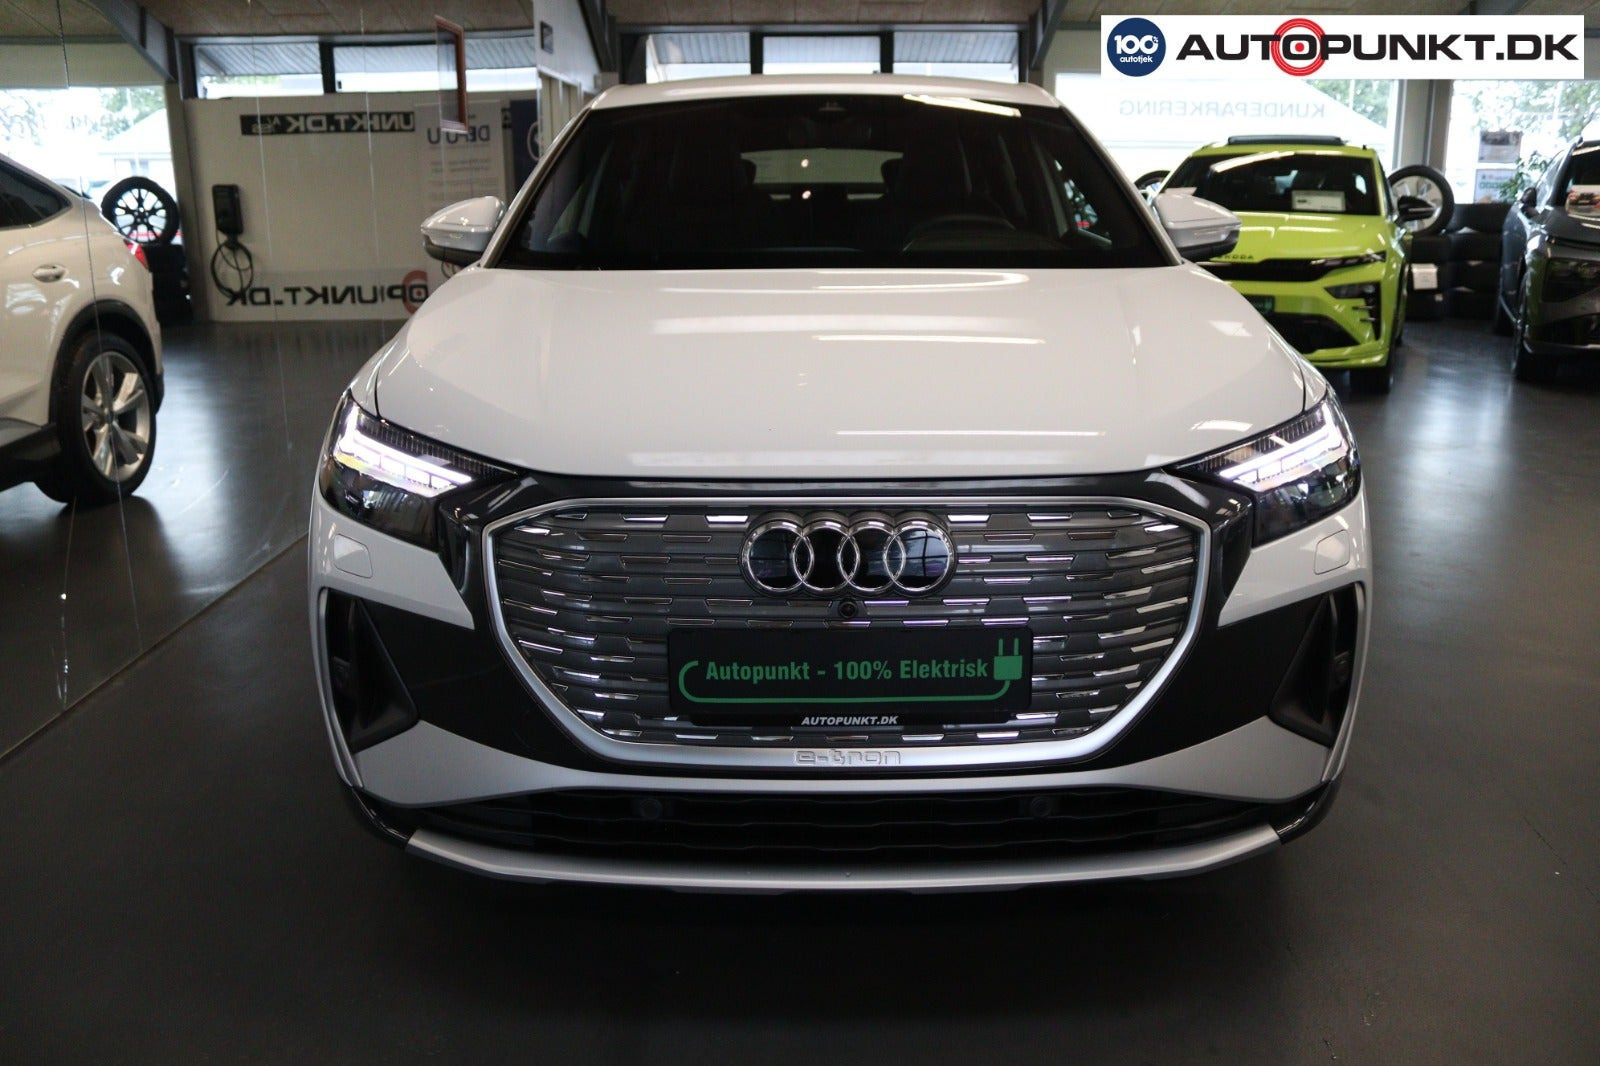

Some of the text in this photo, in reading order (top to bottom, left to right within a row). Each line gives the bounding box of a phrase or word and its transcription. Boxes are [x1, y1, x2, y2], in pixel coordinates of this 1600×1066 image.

[705, 661, 810, 684] Autopunkt
[834, 660, 893, 680] 100%
[900, 658, 988, 680] Elektrisk
[801, 715, 899, 726] AUTOPUNKT.DK
[794, 748, 901, 765] e-tron
